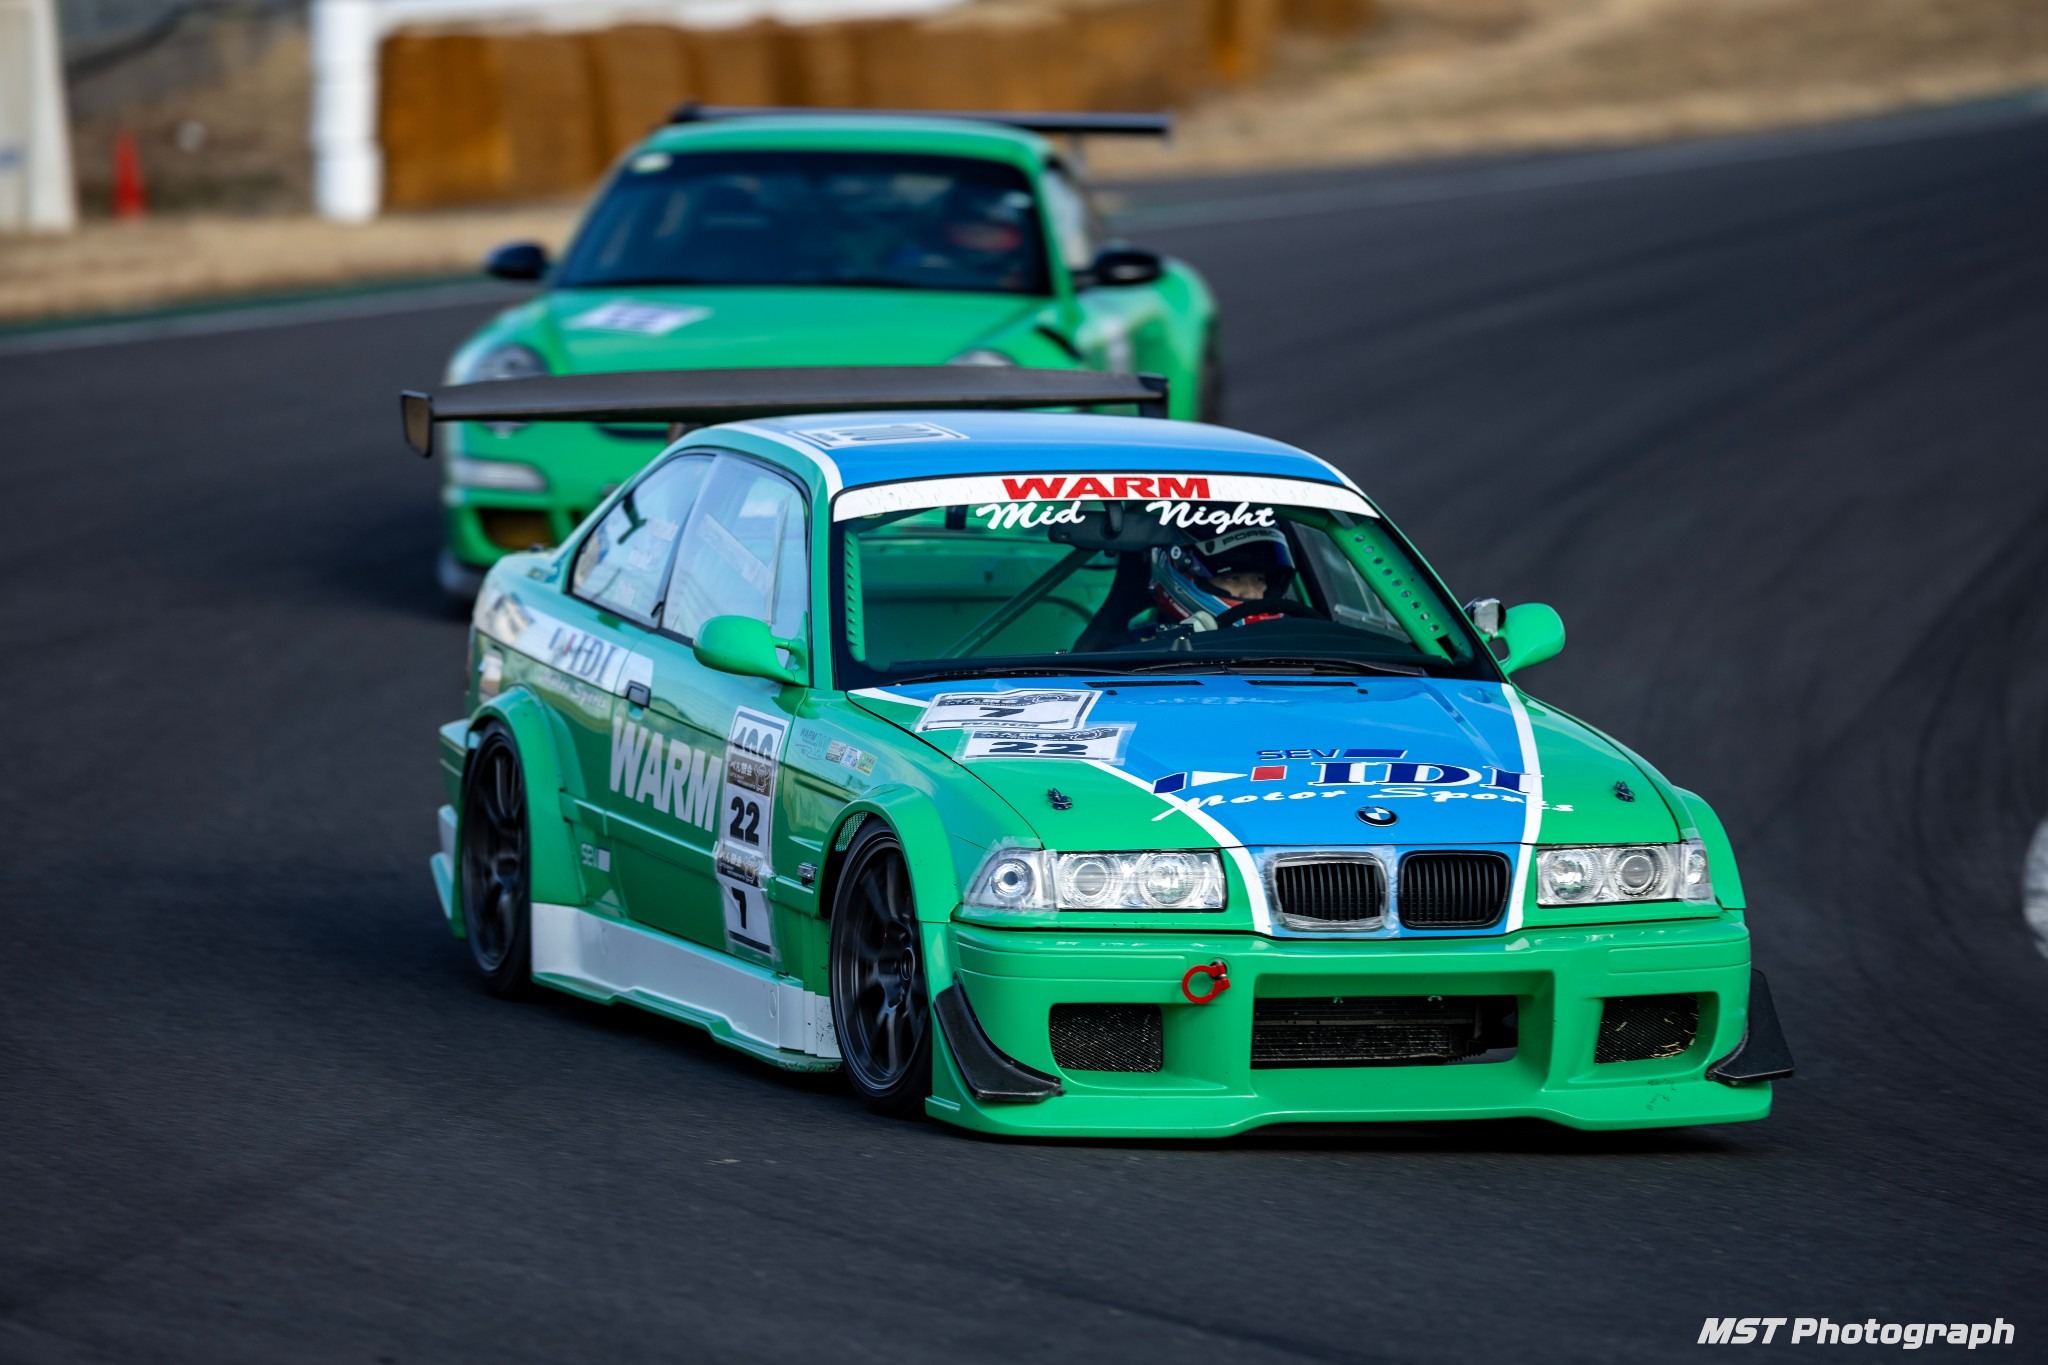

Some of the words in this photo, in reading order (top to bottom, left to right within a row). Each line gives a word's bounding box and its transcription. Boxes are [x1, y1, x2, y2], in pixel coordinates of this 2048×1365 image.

[1001, 477, 1211, 500] WARM
[975, 500, 1086, 530] Mid
[1145, 500, 1276, 535] Night
[979, 706, 1025, 718] 7
[988, 741, 1089, 756] 22
[609, 715, 723, 833] WARM
[1307, 762, 1542, 796] IDI
[729, 796, 760, 847] 22
[1151, 789, 1347, 822] Motor
[731, 886, 747, 930] 7
